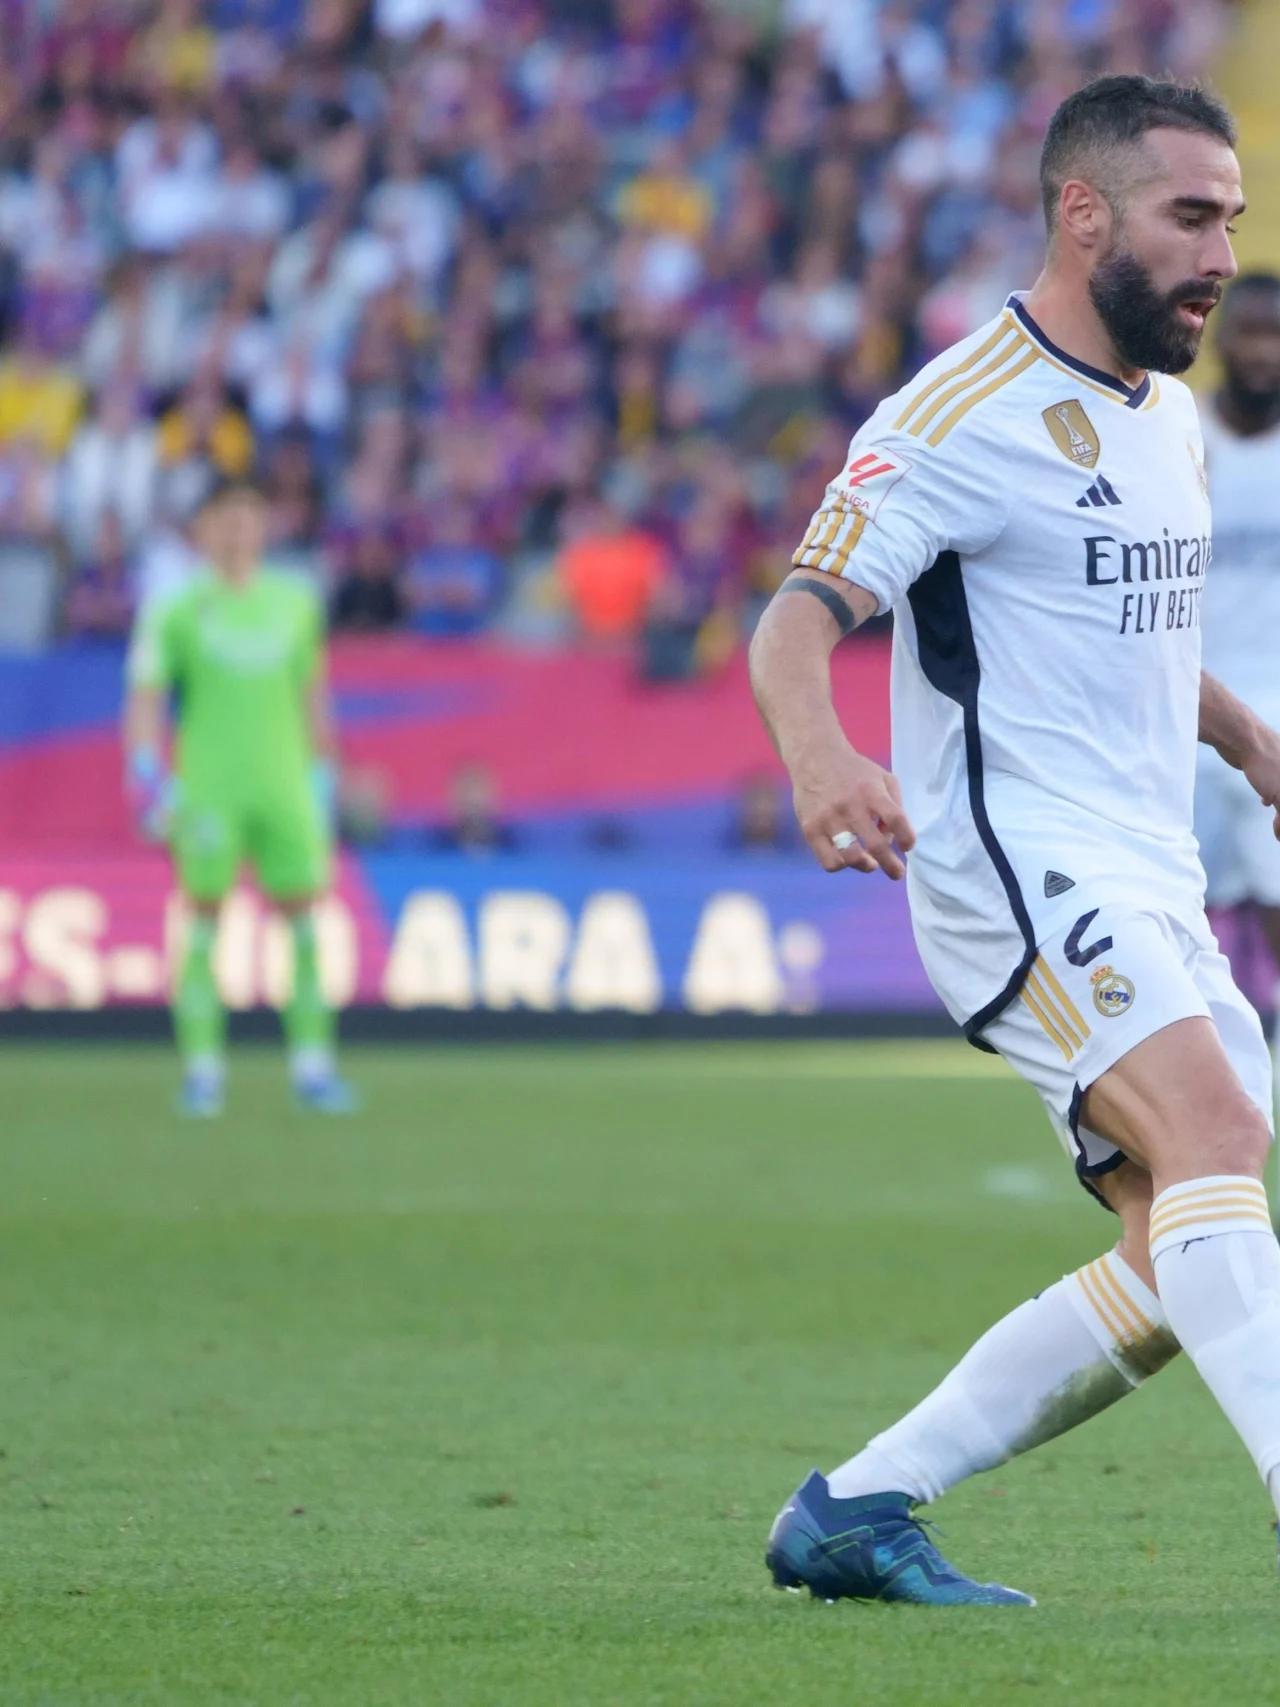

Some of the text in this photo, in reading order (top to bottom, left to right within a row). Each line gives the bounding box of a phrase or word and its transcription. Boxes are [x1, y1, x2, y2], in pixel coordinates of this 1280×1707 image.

[1071, 443, 1093, 457] FIFA
[1119, 586, 1202, 634] FLY BETT
[384, 890, 661, 1014] ARA
